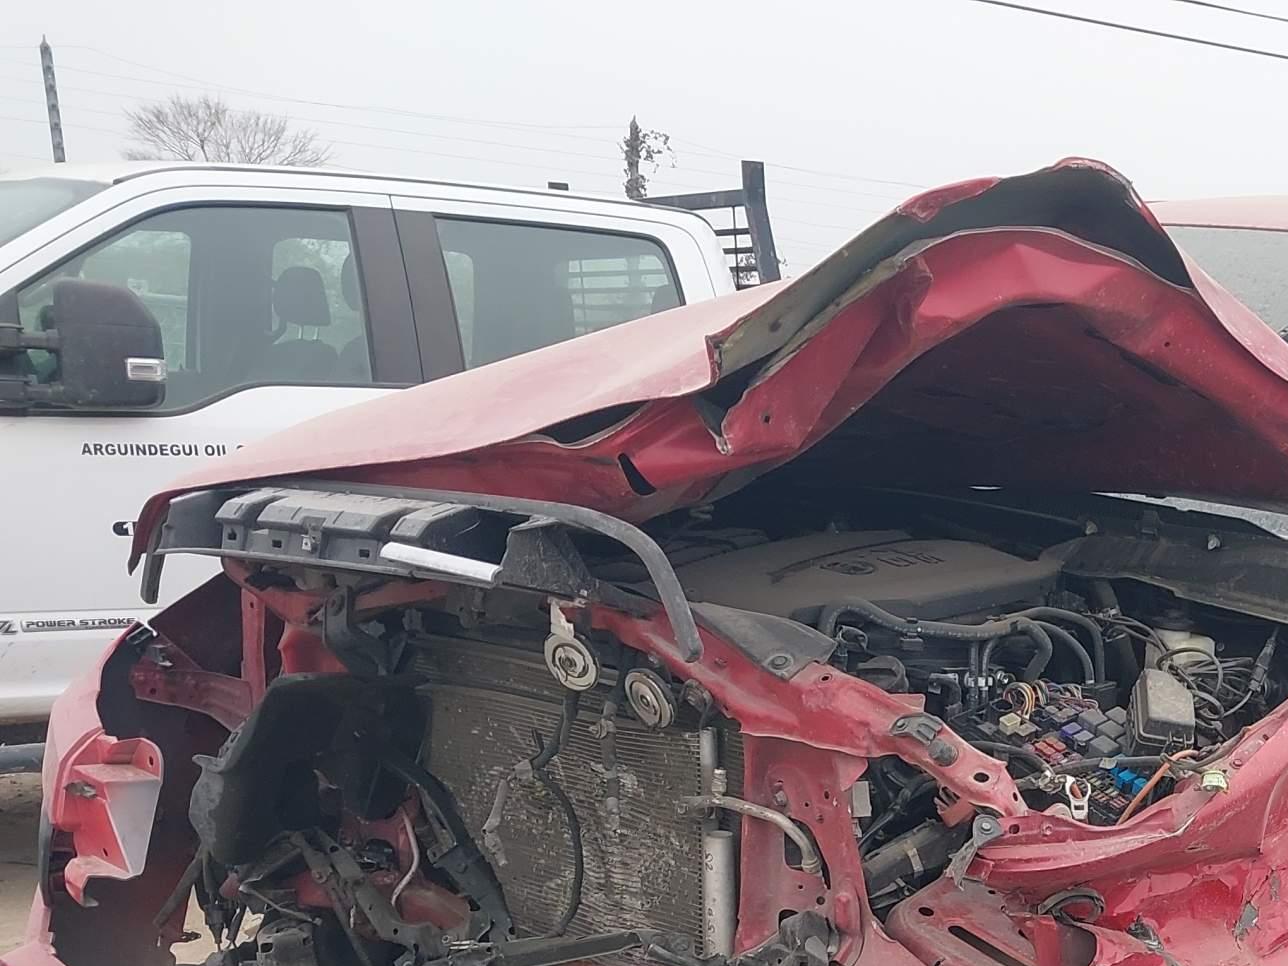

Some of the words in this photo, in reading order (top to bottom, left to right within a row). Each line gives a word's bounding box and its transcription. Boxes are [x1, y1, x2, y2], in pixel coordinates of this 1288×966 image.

[81, 442, 200, 457] ARGUINDEGUI
[25, 619, 76, 629] POWER
[79, 616, 137, 627] STROKE
